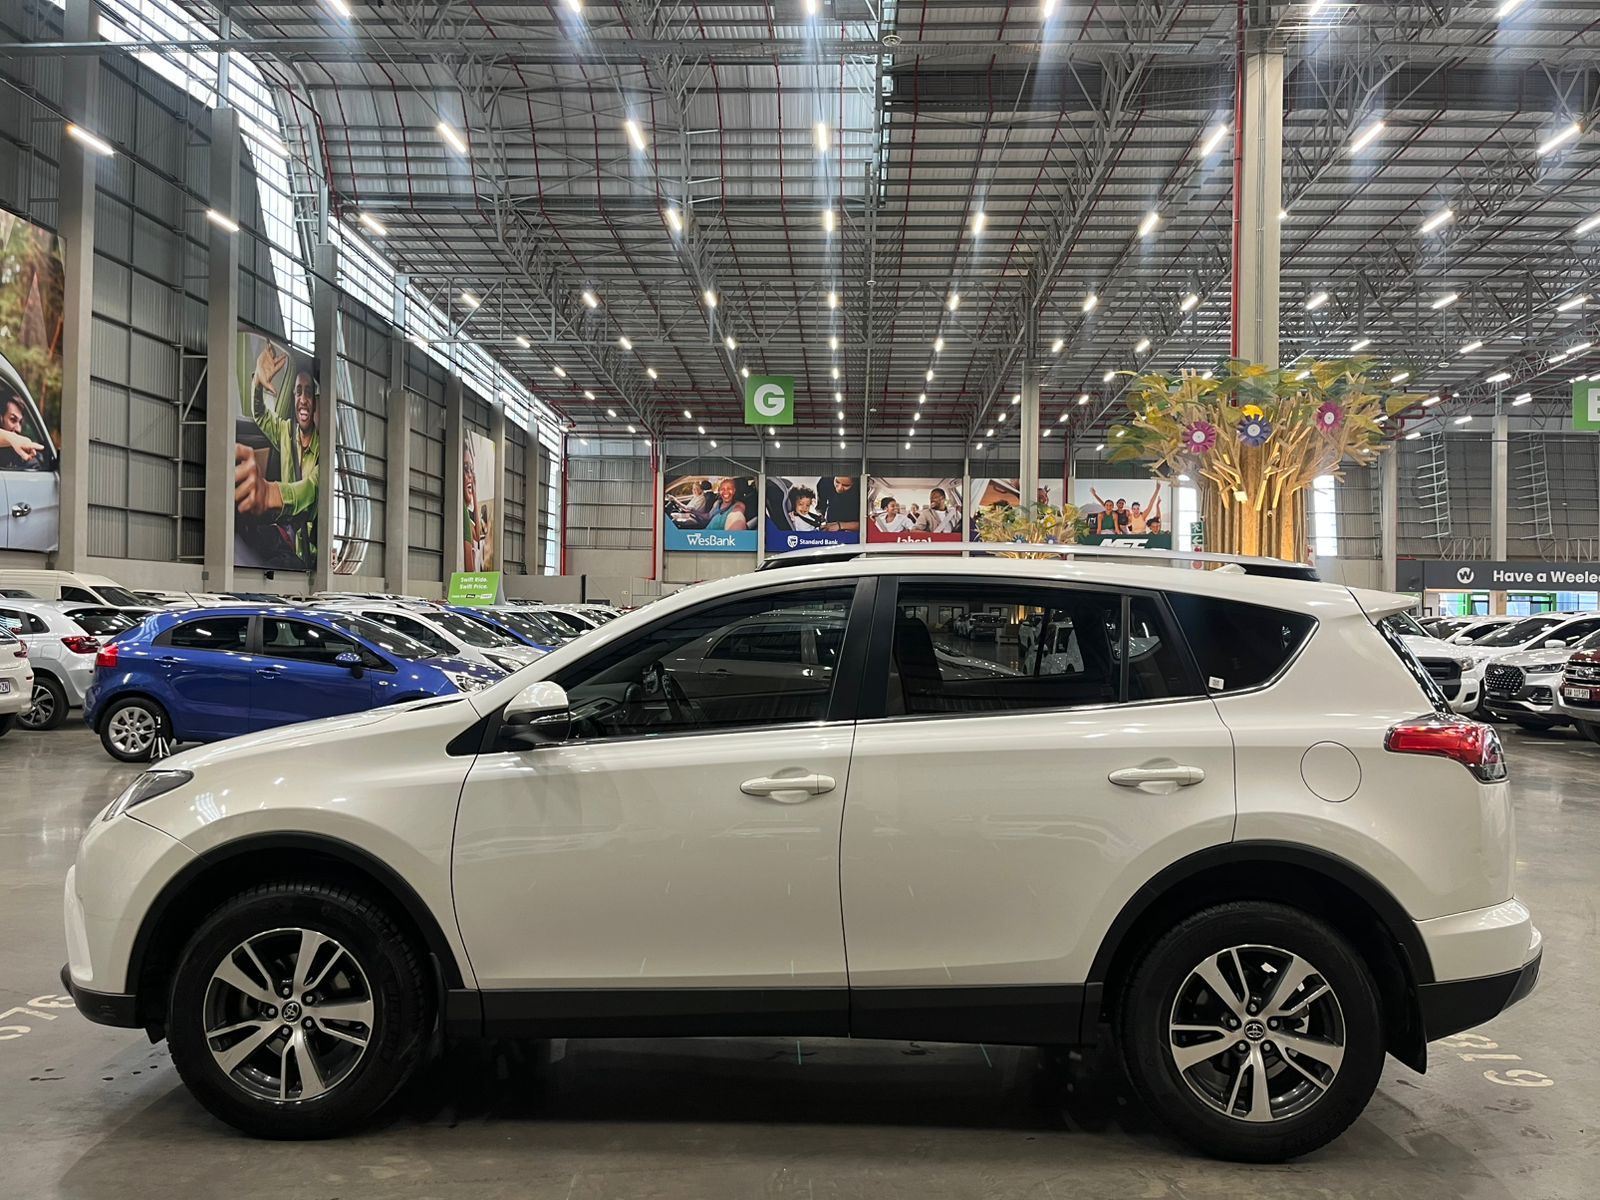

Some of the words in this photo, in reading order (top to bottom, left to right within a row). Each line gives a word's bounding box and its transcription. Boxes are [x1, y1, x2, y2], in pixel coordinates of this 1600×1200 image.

[754, 384, 785, 416] G
[686, 533, 735, 546] WesBank
[1493, 570, 1533, 582] Have
[1536, 572, 1547, 583] a
